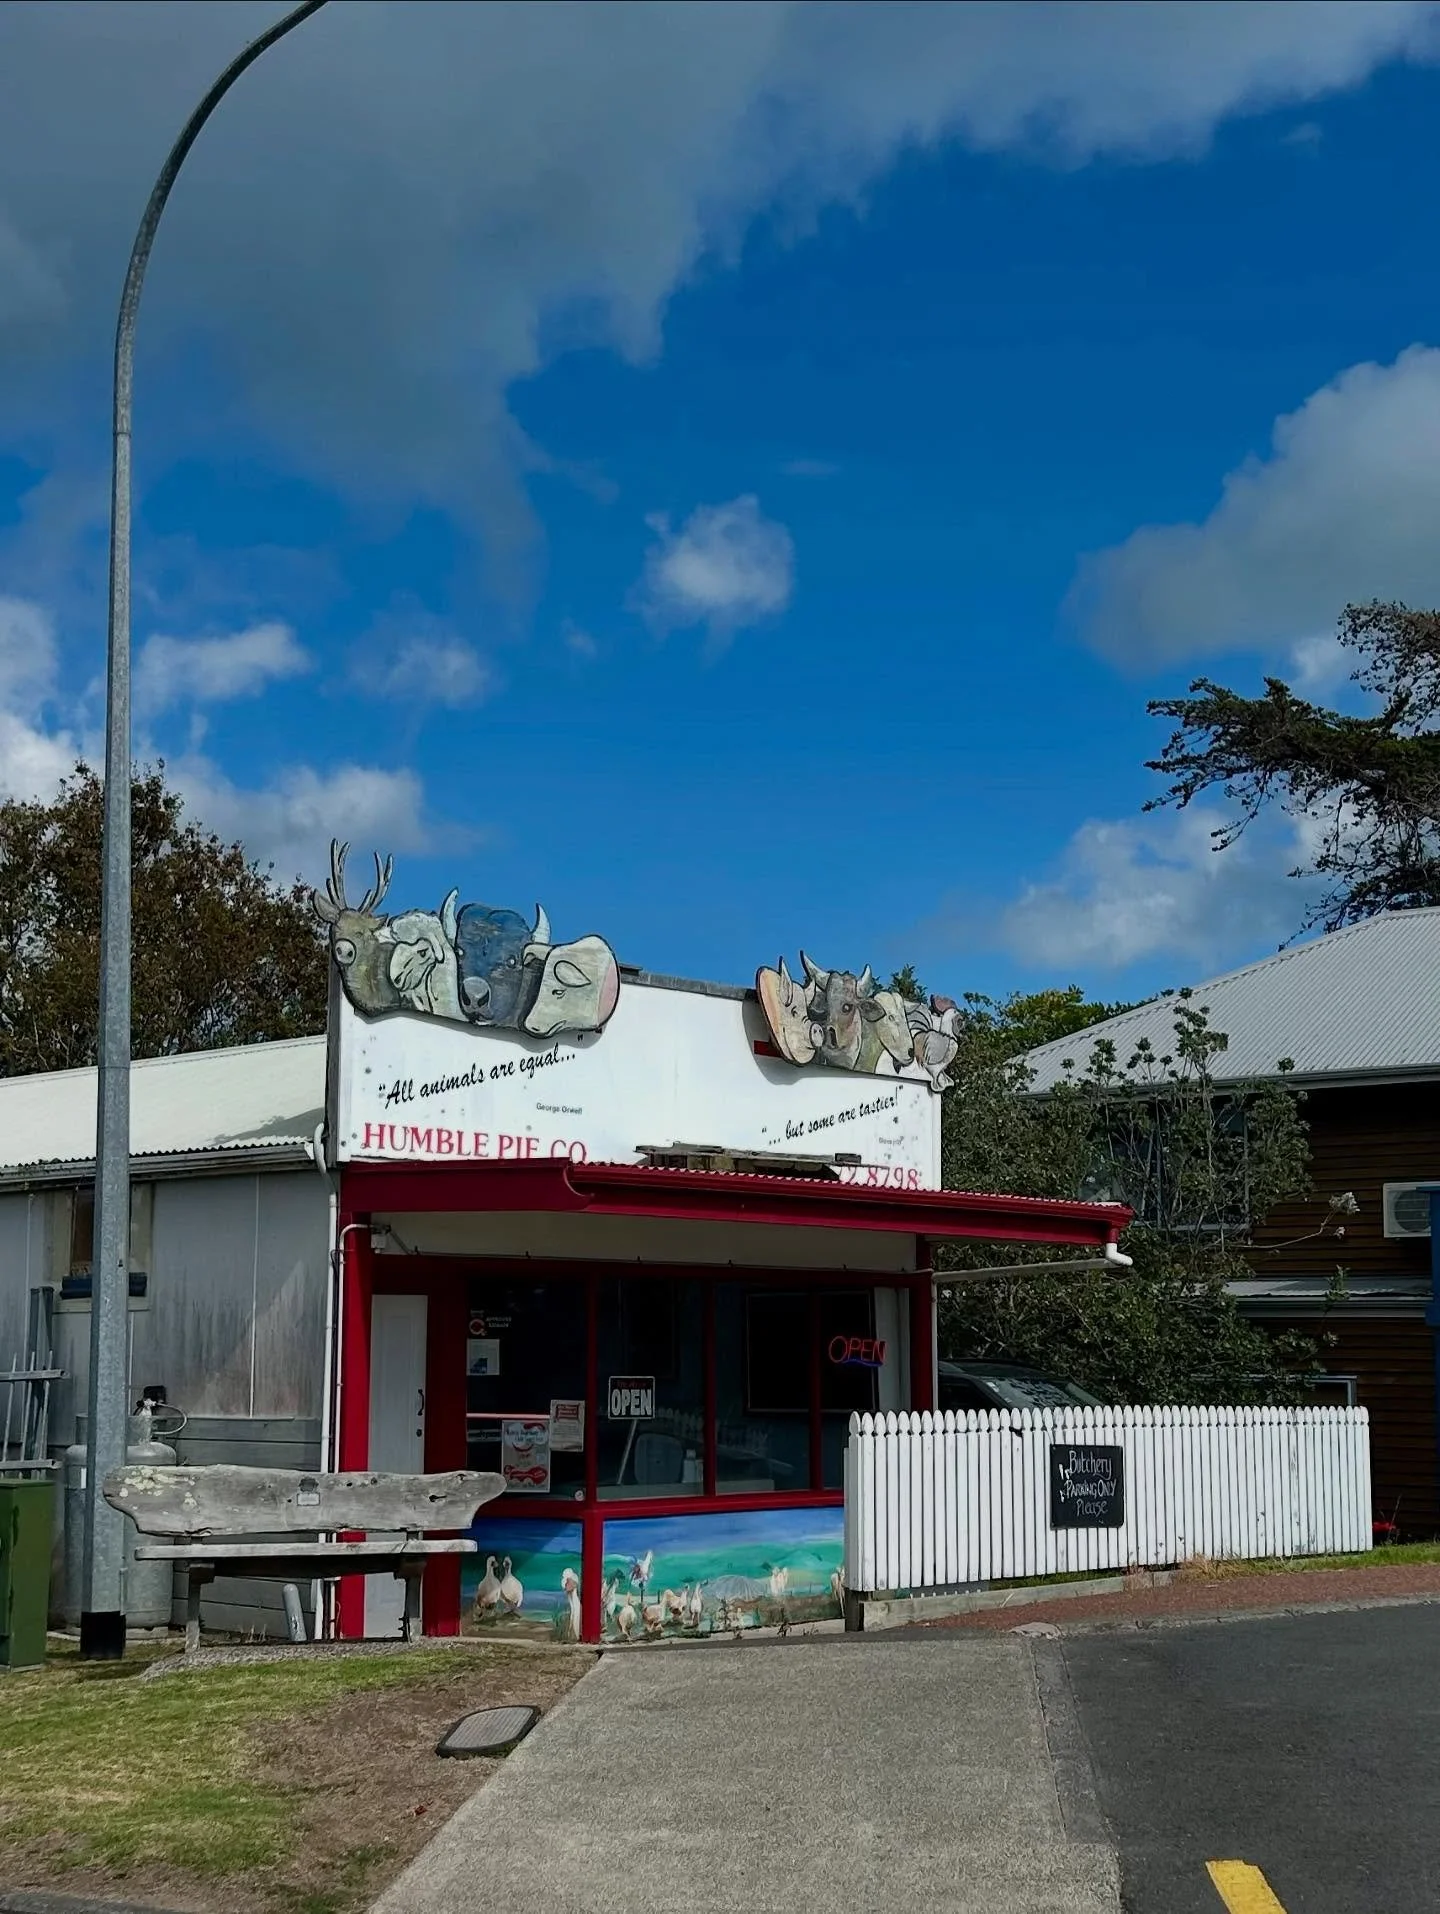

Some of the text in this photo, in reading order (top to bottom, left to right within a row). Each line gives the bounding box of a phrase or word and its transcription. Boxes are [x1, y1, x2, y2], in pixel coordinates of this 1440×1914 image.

[419, 1063, 485, 1098] animals
[489, 1061, 515, 1079] are
[785, 1120, 805, 1139] but
[807, 1115, 835, 1133] some
[838, 1107, 857, 1123] are
[361, 1122, 489, 1157] HUMBLE
[498, 1135, 541, 1159] PIE
[829, 1335, 887, 1364] OPEN
[611, 1388, 653, 1416] OPEN
[1069, 1450, 1112, 1480] Butchery
[1076, 1499, 1108, 1517] Please
